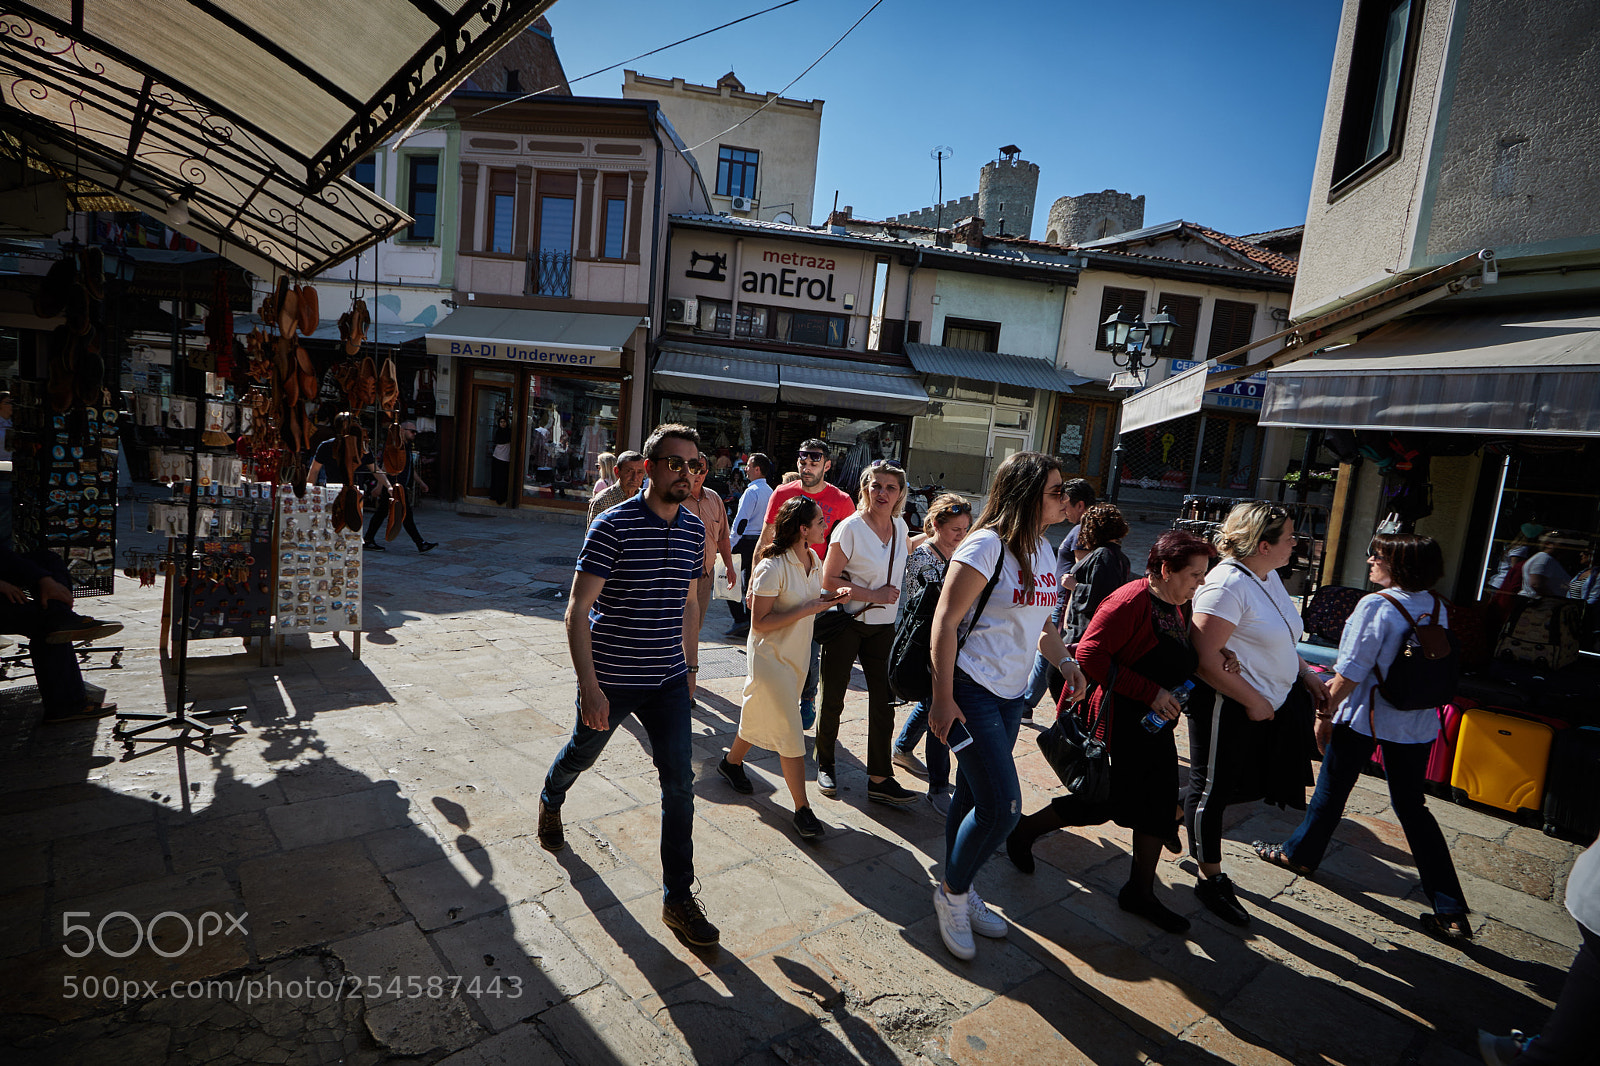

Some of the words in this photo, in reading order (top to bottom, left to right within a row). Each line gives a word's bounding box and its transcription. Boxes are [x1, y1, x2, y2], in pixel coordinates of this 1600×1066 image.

[762, 250, 836, 271] metraza
[741, 268, 836, 302] anErol
[450, 342, 496, 357] BA-DI
[506, 346, 596, 365] Underwear
[1039, 572, 1057, 588] DO
[1012, 588, 1058, 607] NOTHIN
